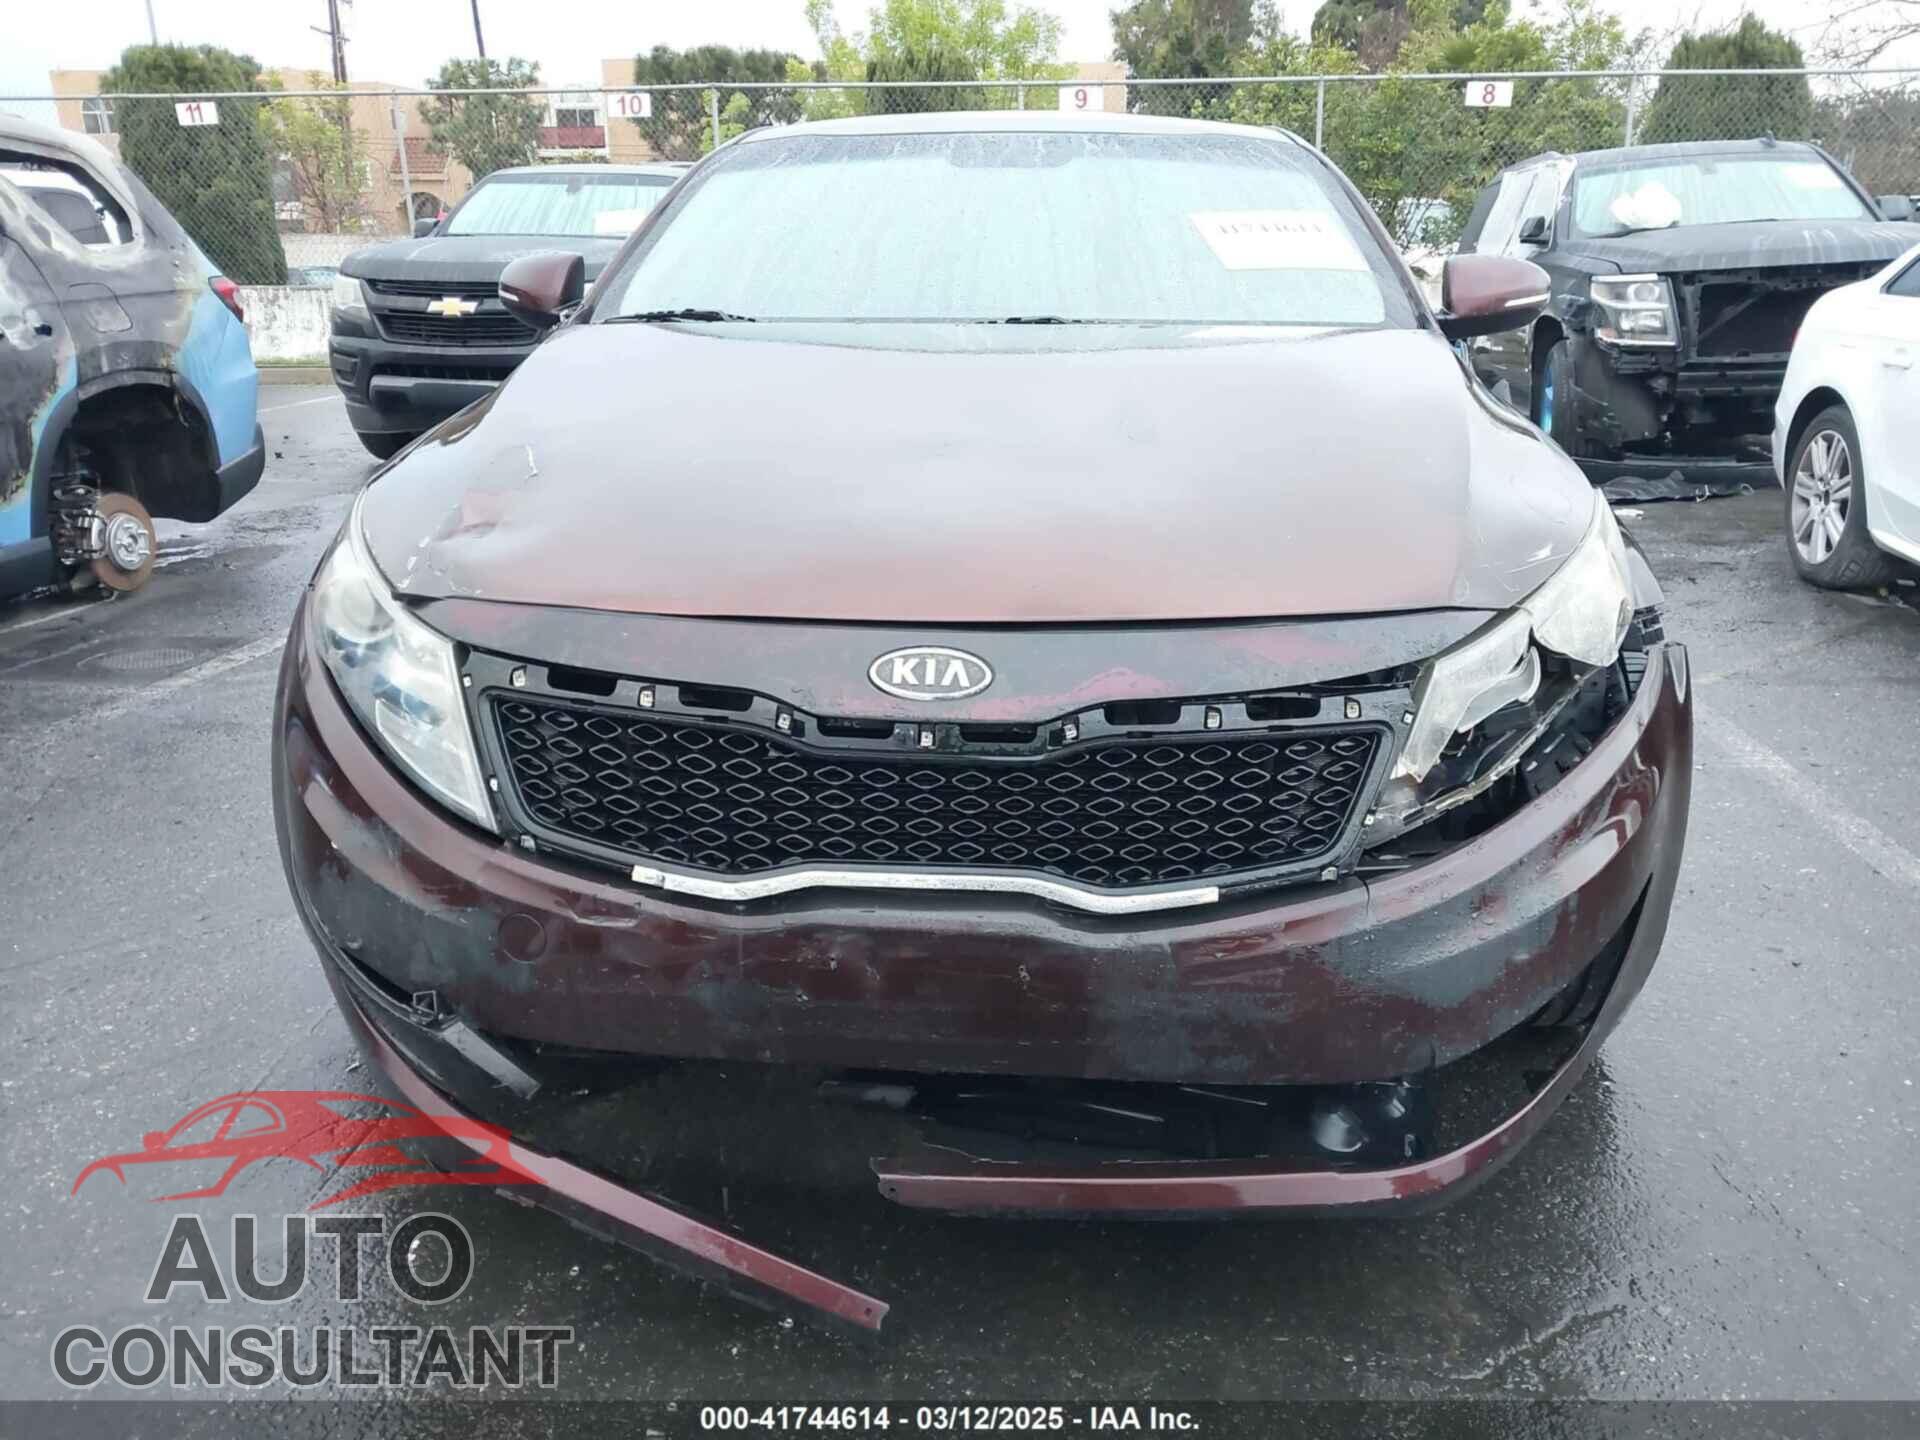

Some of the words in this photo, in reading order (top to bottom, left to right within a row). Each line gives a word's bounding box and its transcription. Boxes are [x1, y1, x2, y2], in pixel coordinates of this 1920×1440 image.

[1074, 88, 1088, 108] 9
[1482, 83, 1496, 104] 8
[185, 102, 204, 123] 11
[617, 95, 642, 115] 10
[892, 658, 970, 687] KIA
